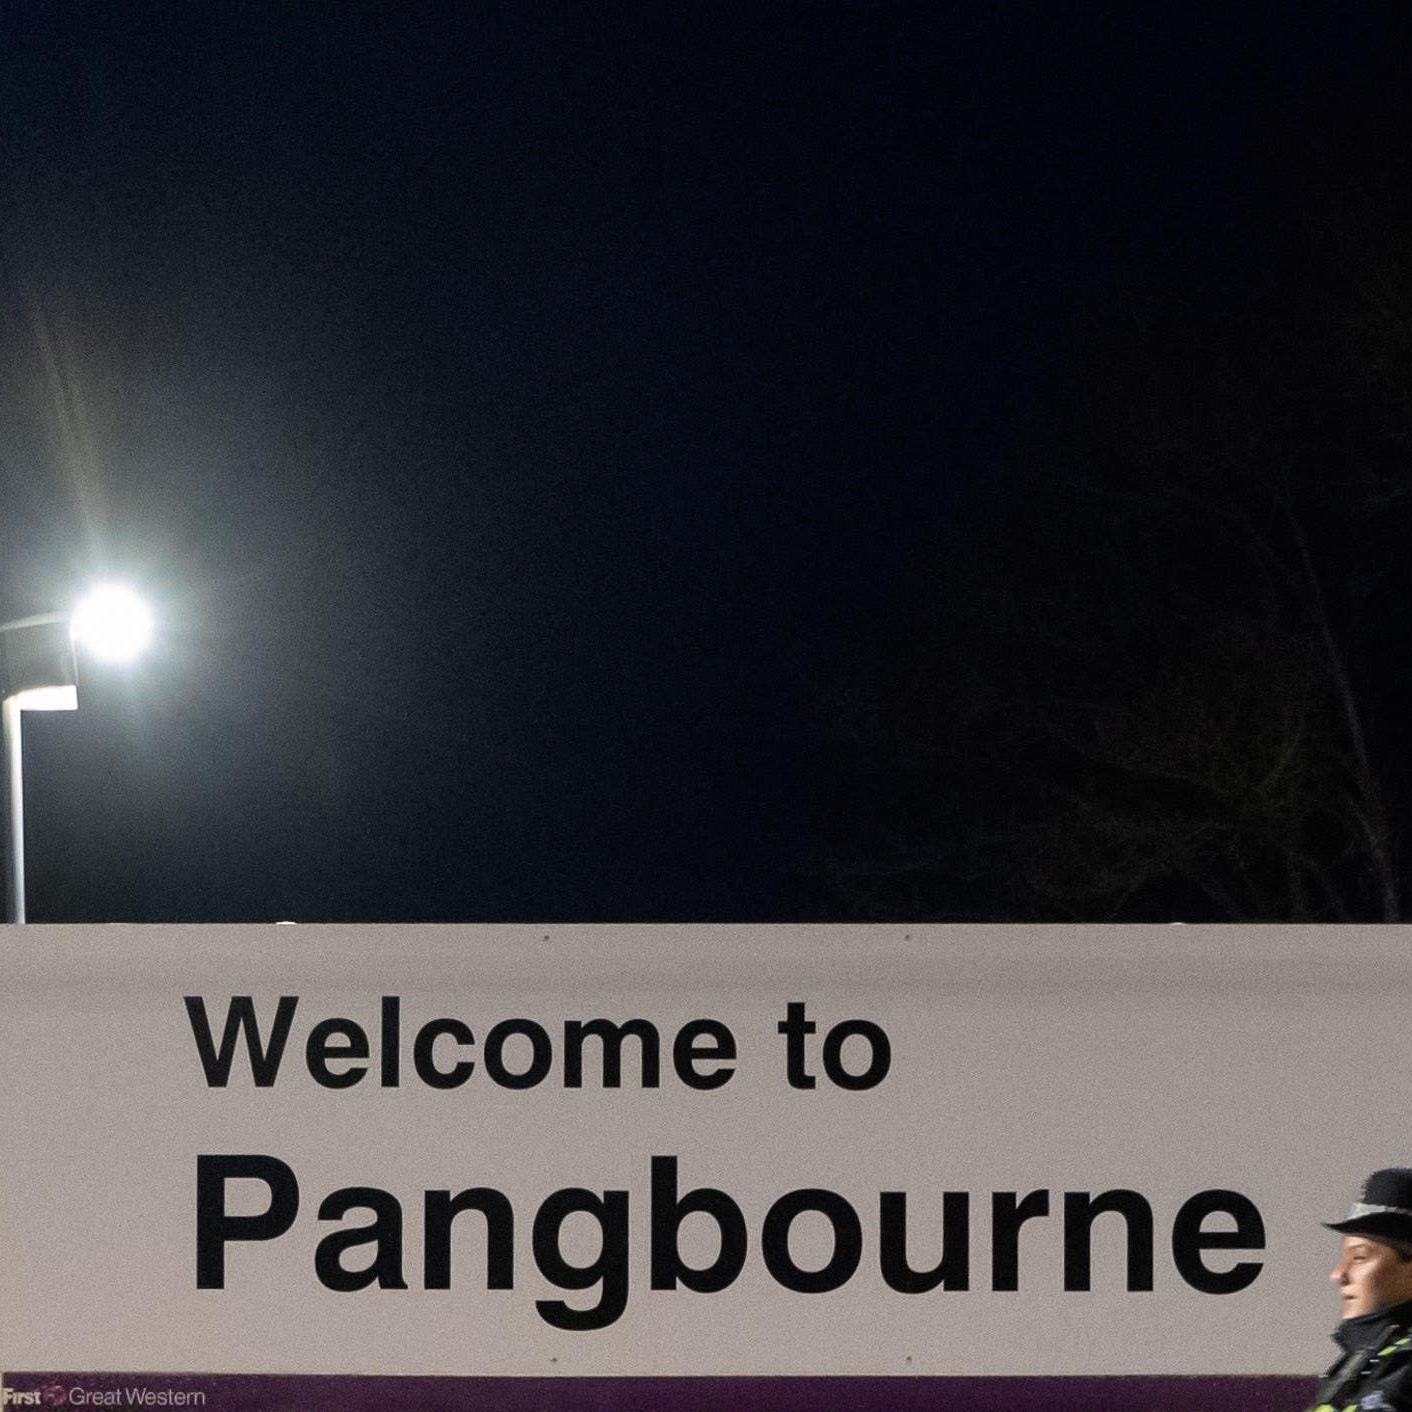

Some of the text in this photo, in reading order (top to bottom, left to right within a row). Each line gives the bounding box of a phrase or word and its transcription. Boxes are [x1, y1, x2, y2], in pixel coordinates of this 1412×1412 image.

[183, 995, 892, 1092] Welcome to
[196, 1154, 1266, 1332] Pangbourne
[3, 1387, 206, 1406] First Great Western
